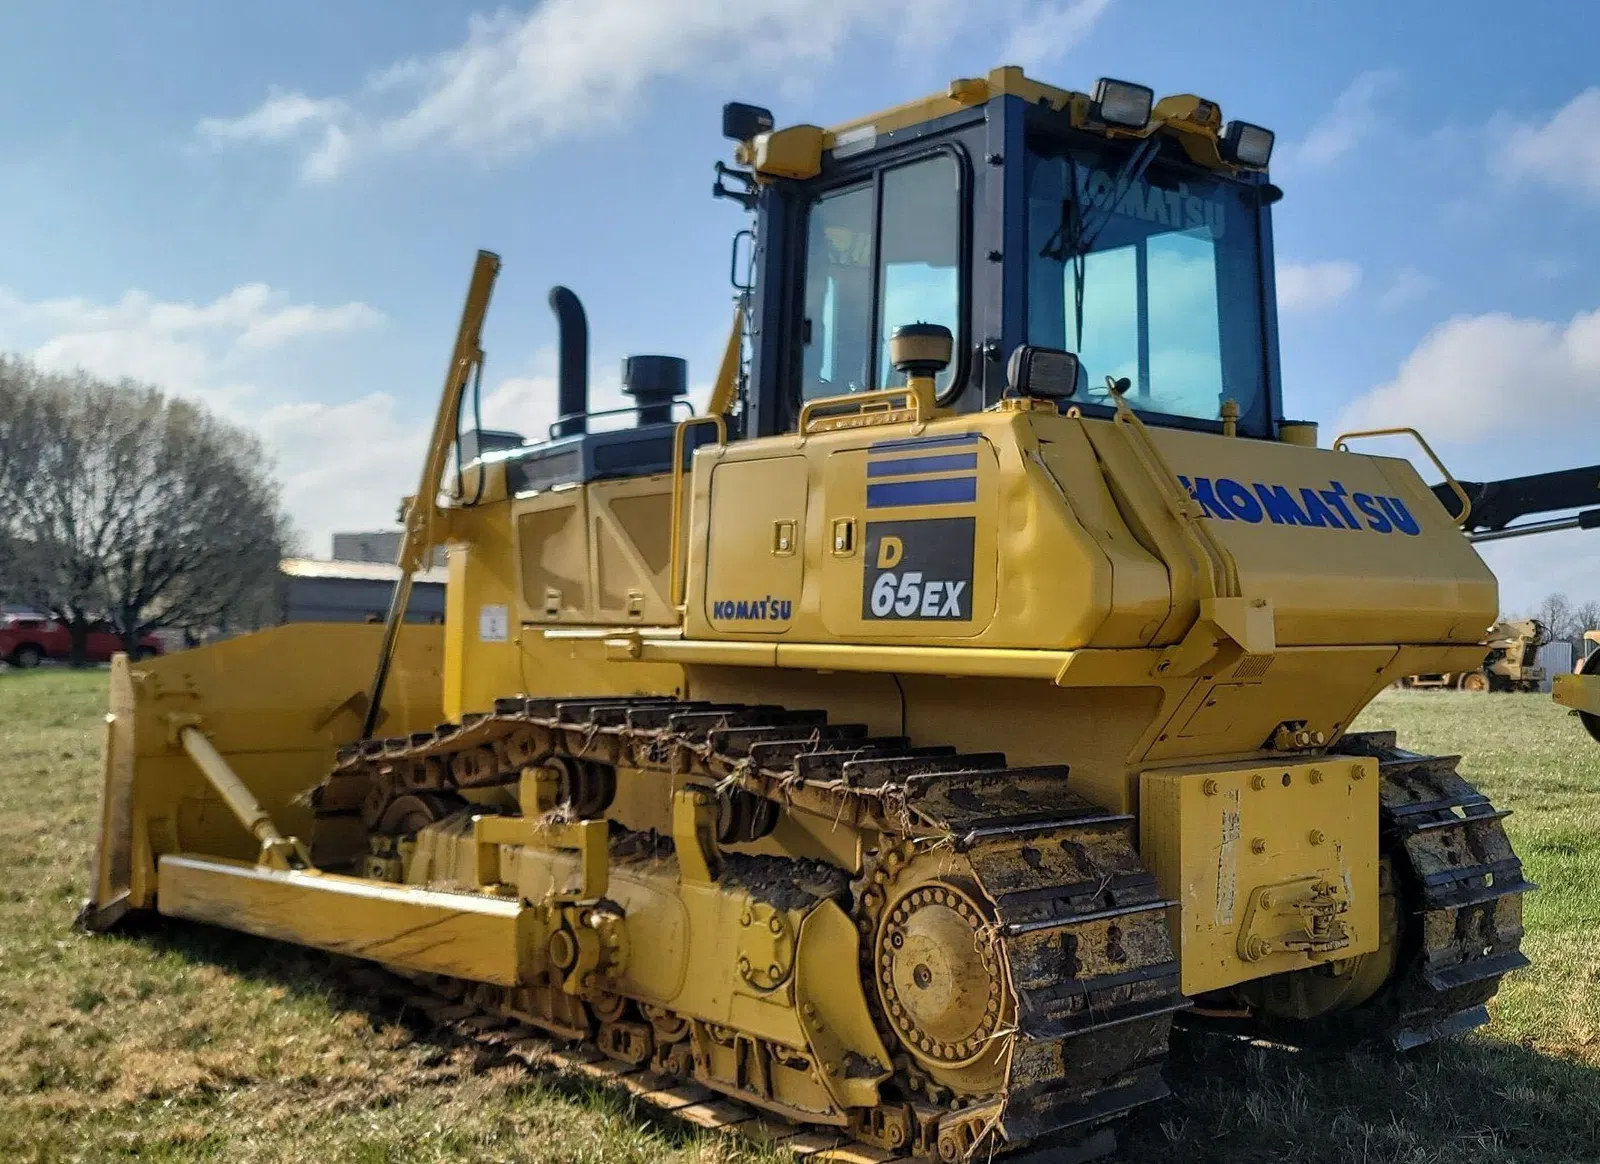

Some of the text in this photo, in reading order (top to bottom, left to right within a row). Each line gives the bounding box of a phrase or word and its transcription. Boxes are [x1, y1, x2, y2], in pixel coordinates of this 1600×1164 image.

[1177, 475, 1420, 536] KOMATSU
[877, 536, 903, 569] D
[713, 595, 792, 620] KOMATSU
[871, 572, 966, 617] 65EX
